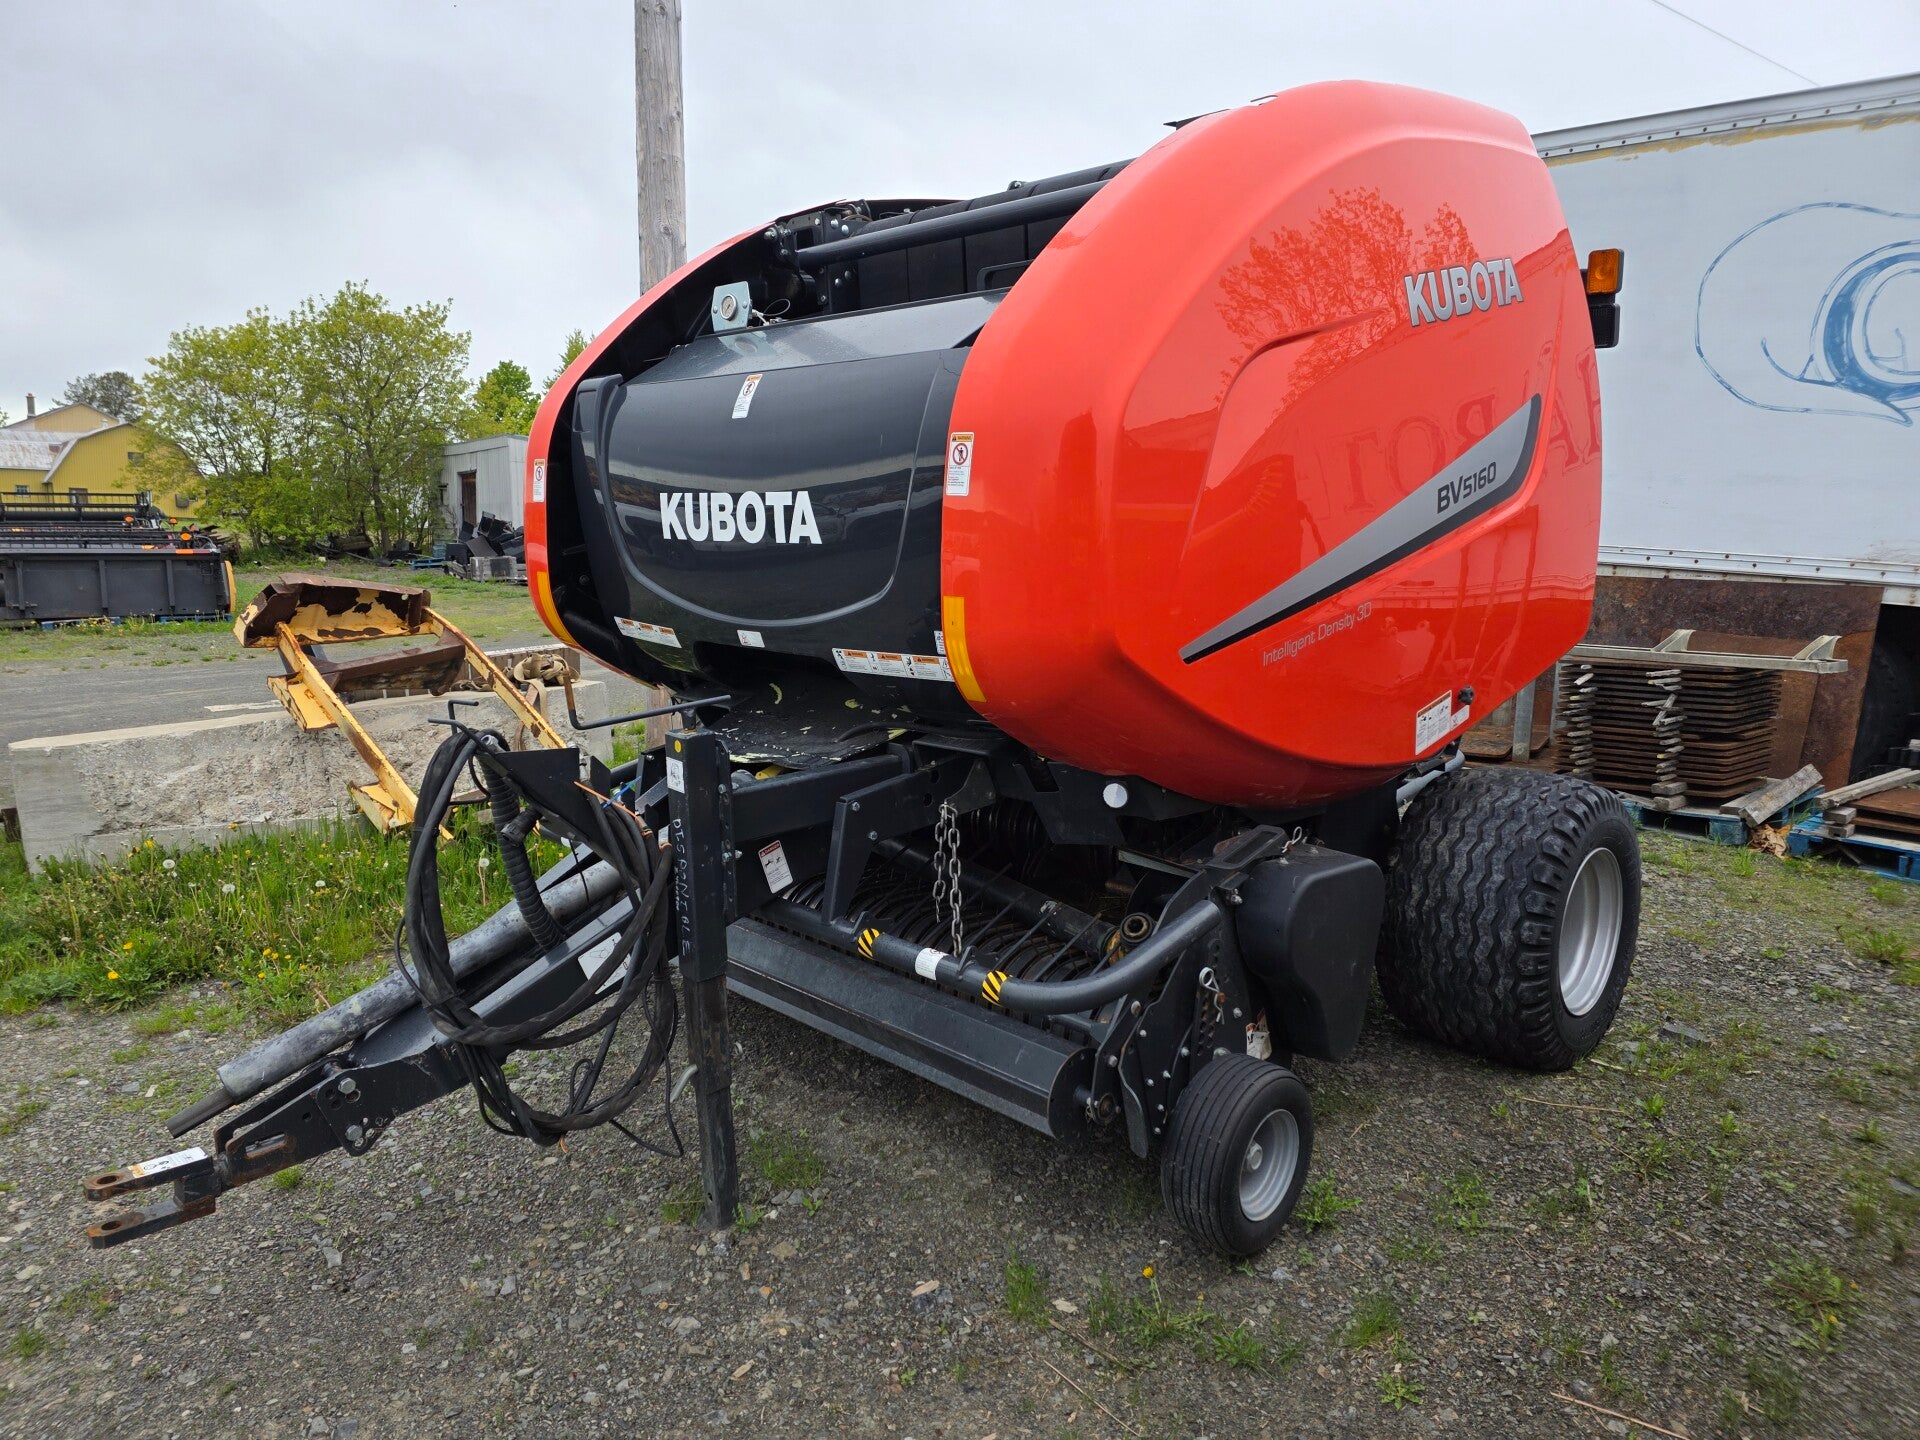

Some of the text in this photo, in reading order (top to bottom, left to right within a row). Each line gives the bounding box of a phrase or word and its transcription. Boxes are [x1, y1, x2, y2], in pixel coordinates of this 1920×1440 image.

[1404, 258, 1524, 327] KUBOTA
[659, 490, 823, 544] KUBOTA
[1436, 461, 1497, 514] BV5160
[1262, 601, 1373, 667] Intelligent Density 3D
